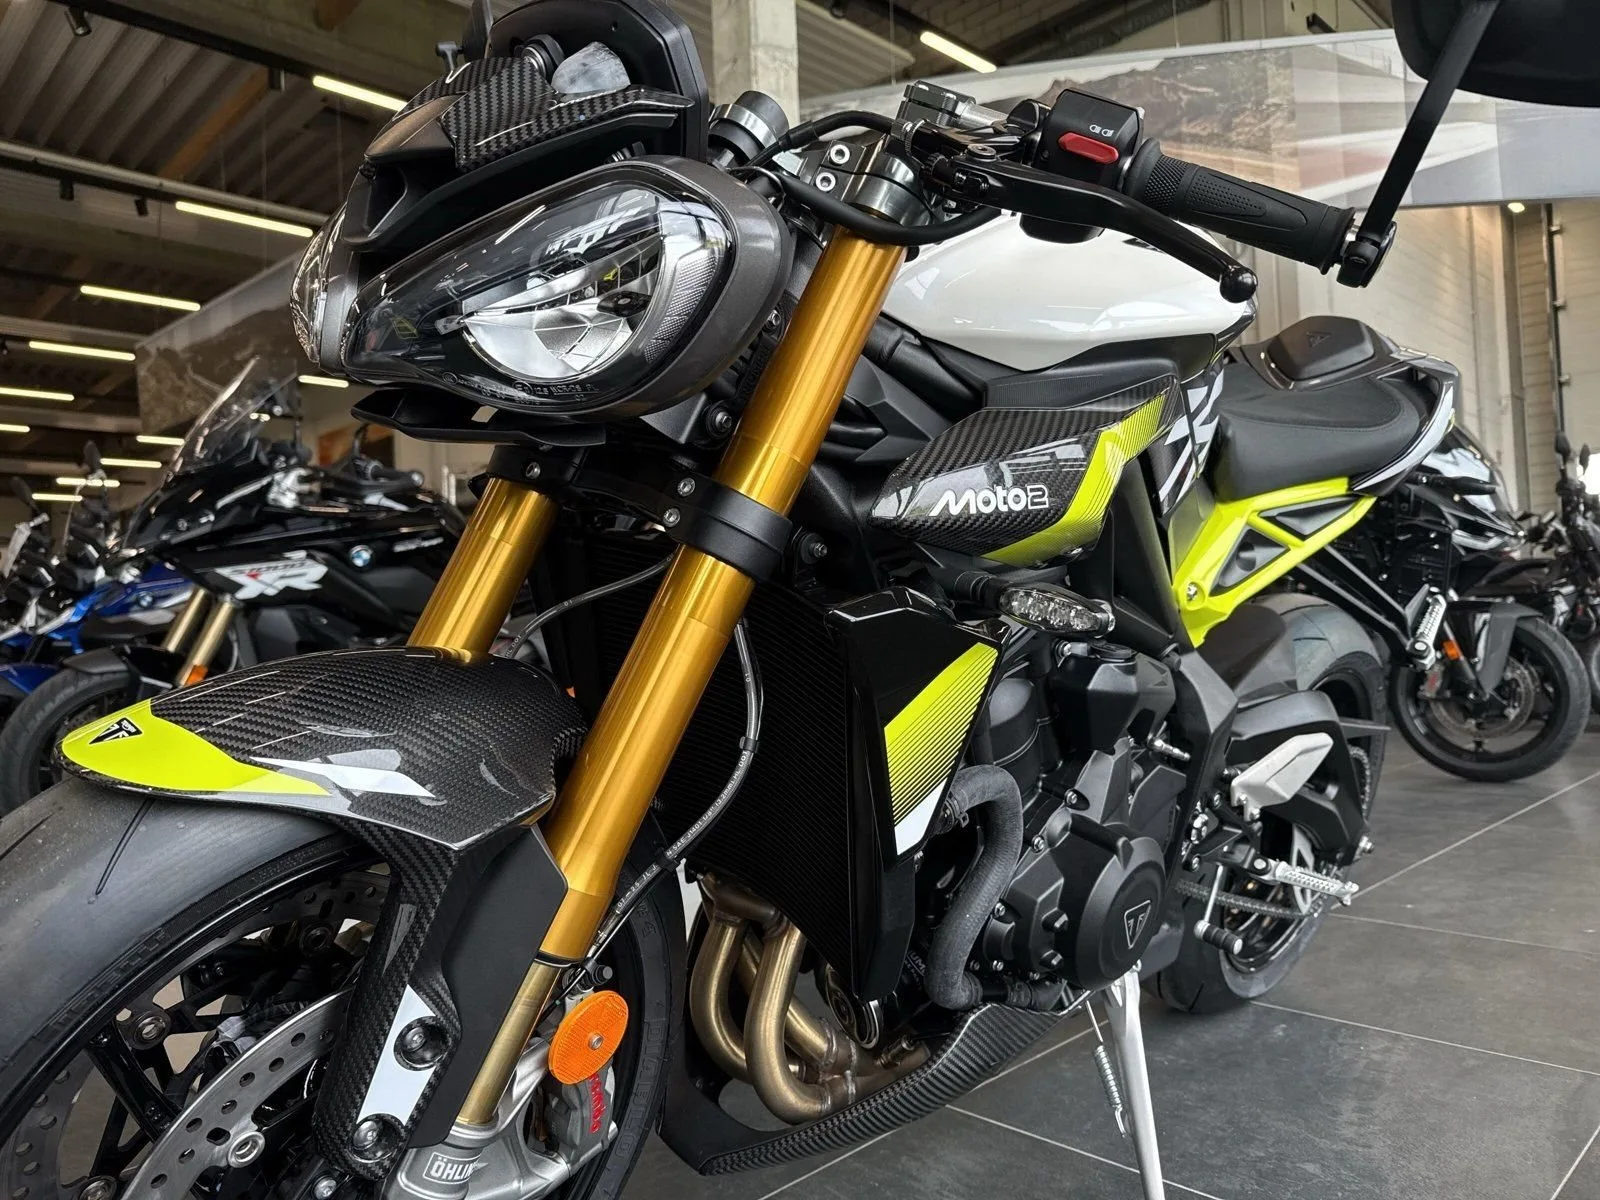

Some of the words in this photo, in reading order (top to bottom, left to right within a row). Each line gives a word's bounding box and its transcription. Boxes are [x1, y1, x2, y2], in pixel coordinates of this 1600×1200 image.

[928, 484, 1049, 516] Moto2
[672, 836, 687, 850] SAE
[687, 820, 703, 838] J1401
